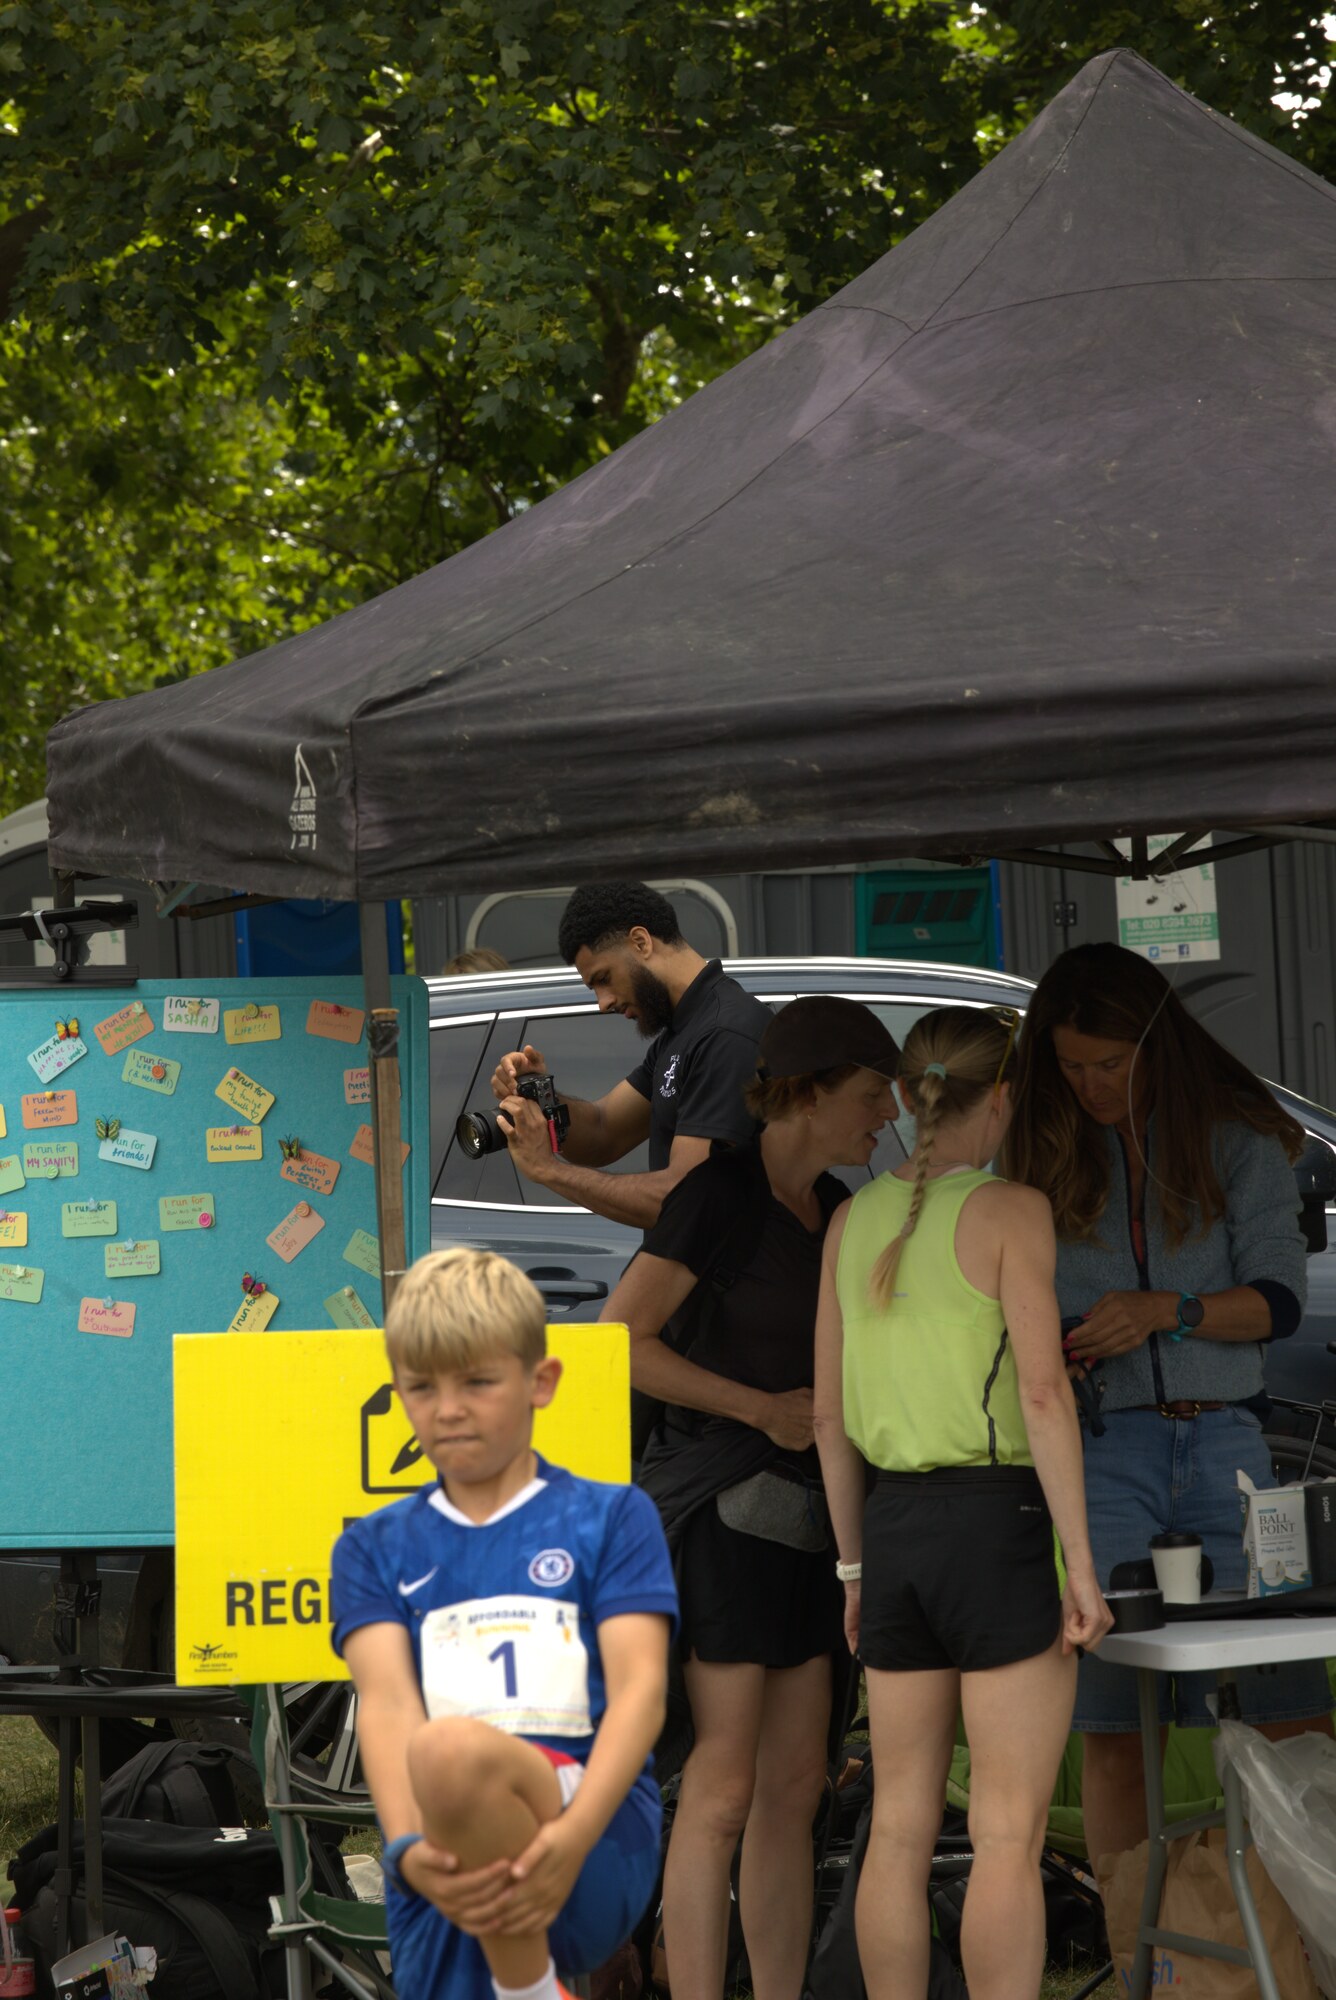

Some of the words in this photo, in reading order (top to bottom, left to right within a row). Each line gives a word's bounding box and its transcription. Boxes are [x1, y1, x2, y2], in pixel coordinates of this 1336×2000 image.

[168, 1012, 217, 1031] SASHA!
[36, 1145, 54, 1154] run
[56, 1144, 68, 1154] for
[130, 1140, 146, 1151] for
[27, 1156, 40, 1168] MY
[42, 1156, 76, 1170] SANITY
[171, 1199, 188, 1208] run
[191, 1196, 206, 1205] for
[236, 1308, 250, 1326] run
[1322, 1496, 1332, 1523] SONOS
[1258, 1513, 1290, 1525] BALL
[1260, 1523, 1296, 1536] POINT
[488, 1640, 518, 1698] 1
